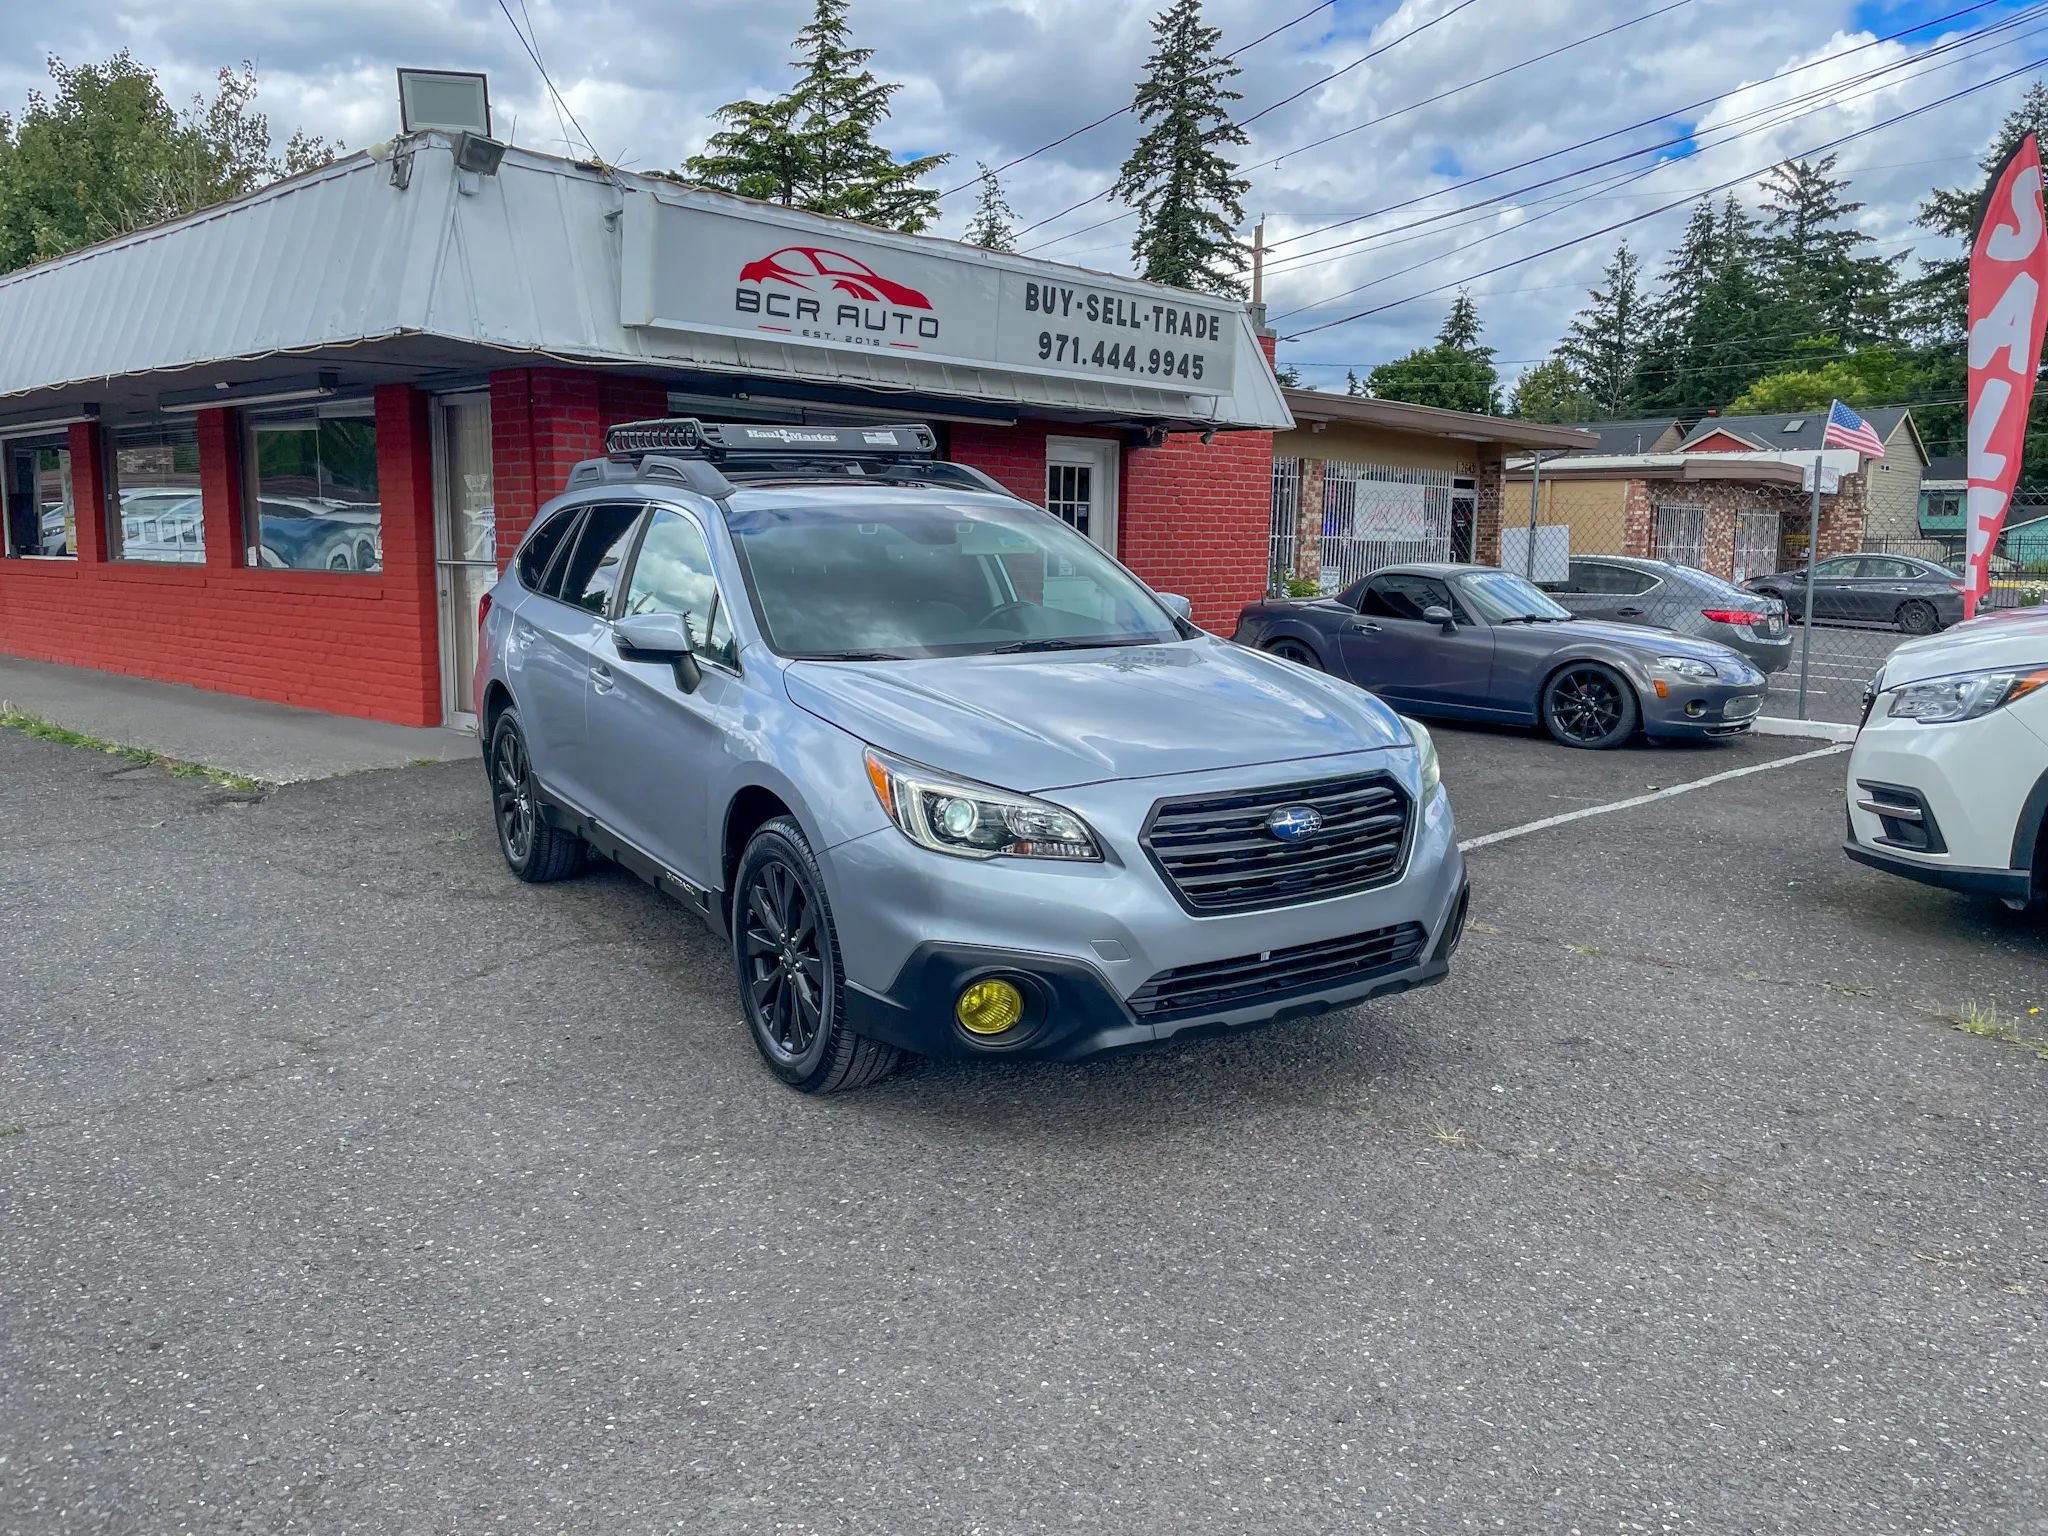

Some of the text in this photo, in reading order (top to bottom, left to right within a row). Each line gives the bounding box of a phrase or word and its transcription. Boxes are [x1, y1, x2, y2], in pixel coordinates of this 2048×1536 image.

[735, 287, 939, 339] BCR AUTO
[802, 328, 881, 346] EST. 2015
[1038, 331, 1204, 380] 971.444.9945
[1967, 165, 2045, 592] SALE
